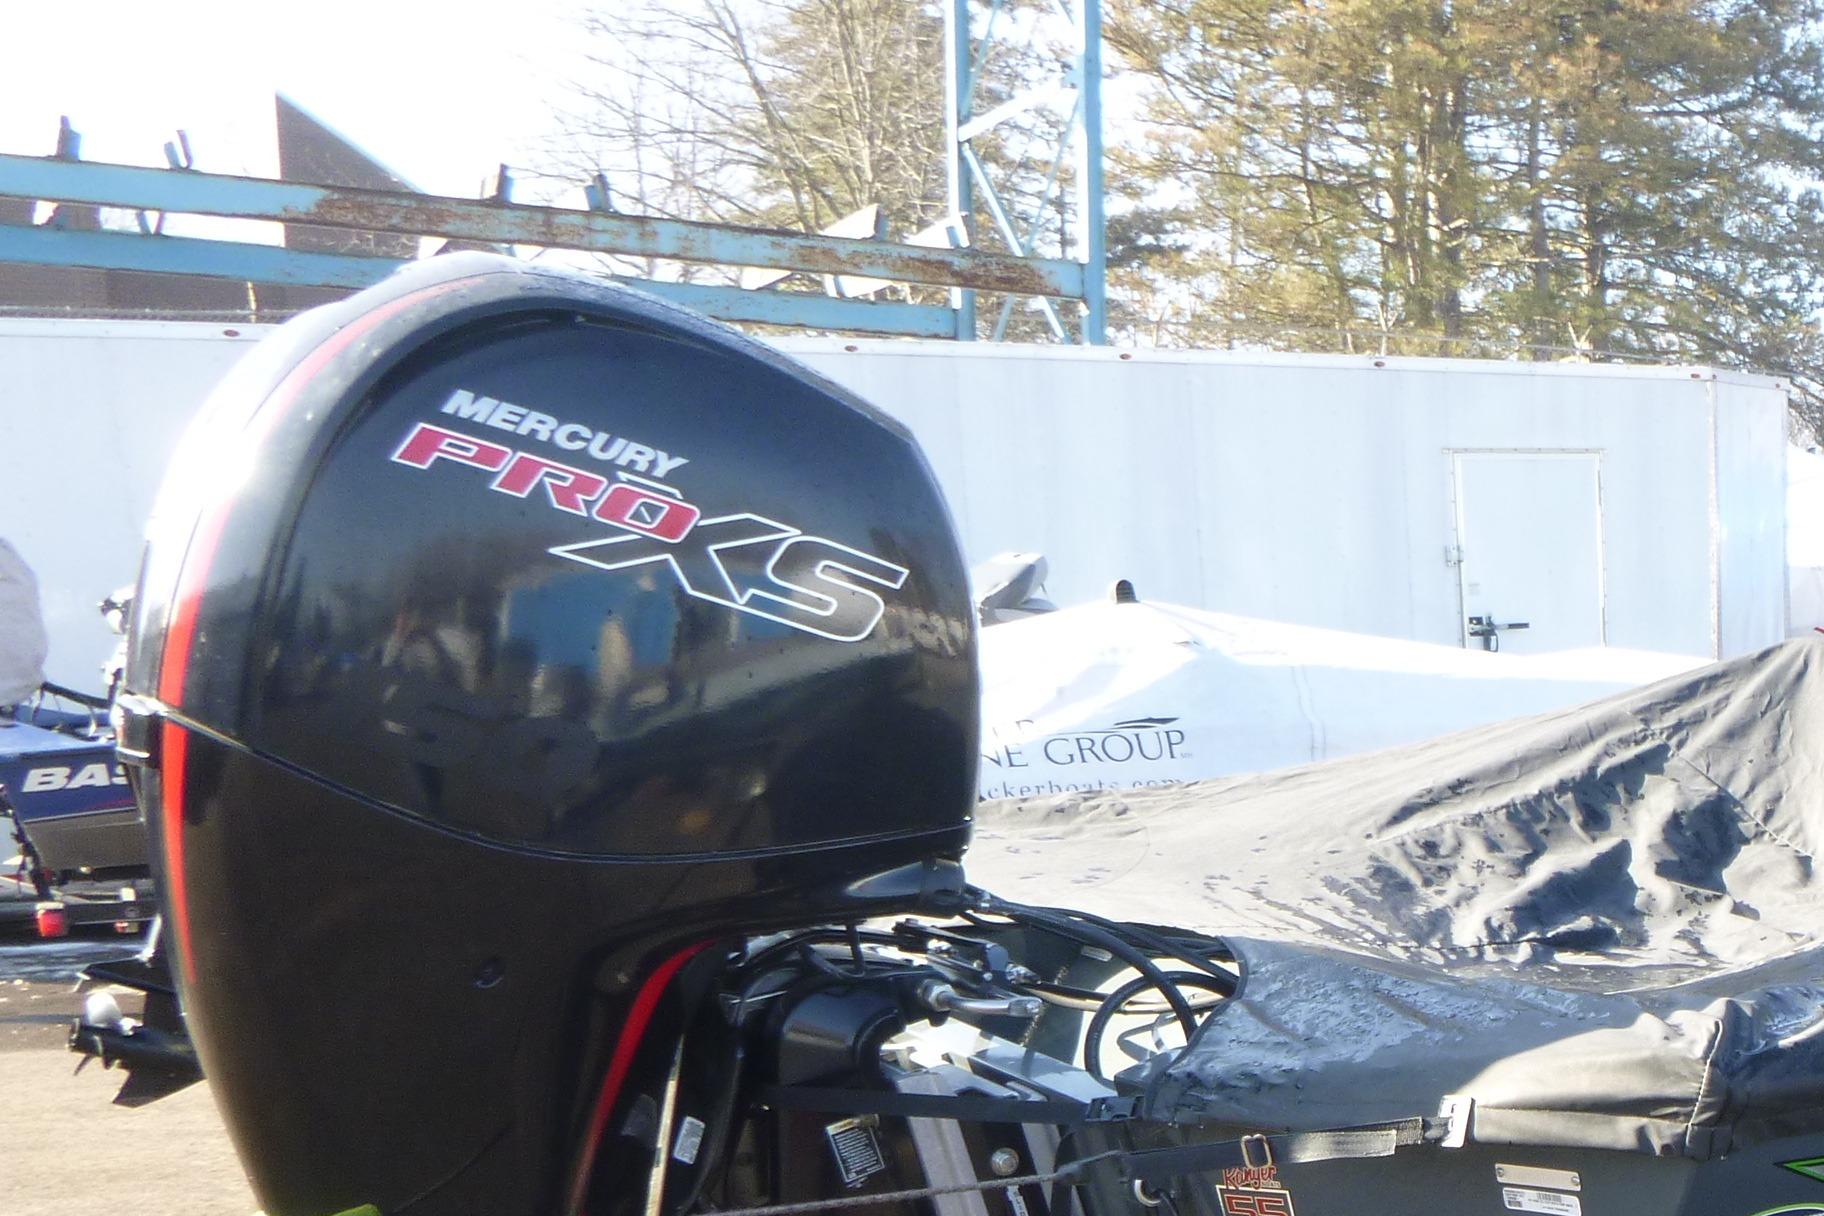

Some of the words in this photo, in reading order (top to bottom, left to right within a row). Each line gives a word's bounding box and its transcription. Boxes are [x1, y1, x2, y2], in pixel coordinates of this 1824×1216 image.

[441, 388, 688, 479] MERCURY
[391, 422, 700, 544] PRO
[1043, 730, 1186, 767] GROUP
